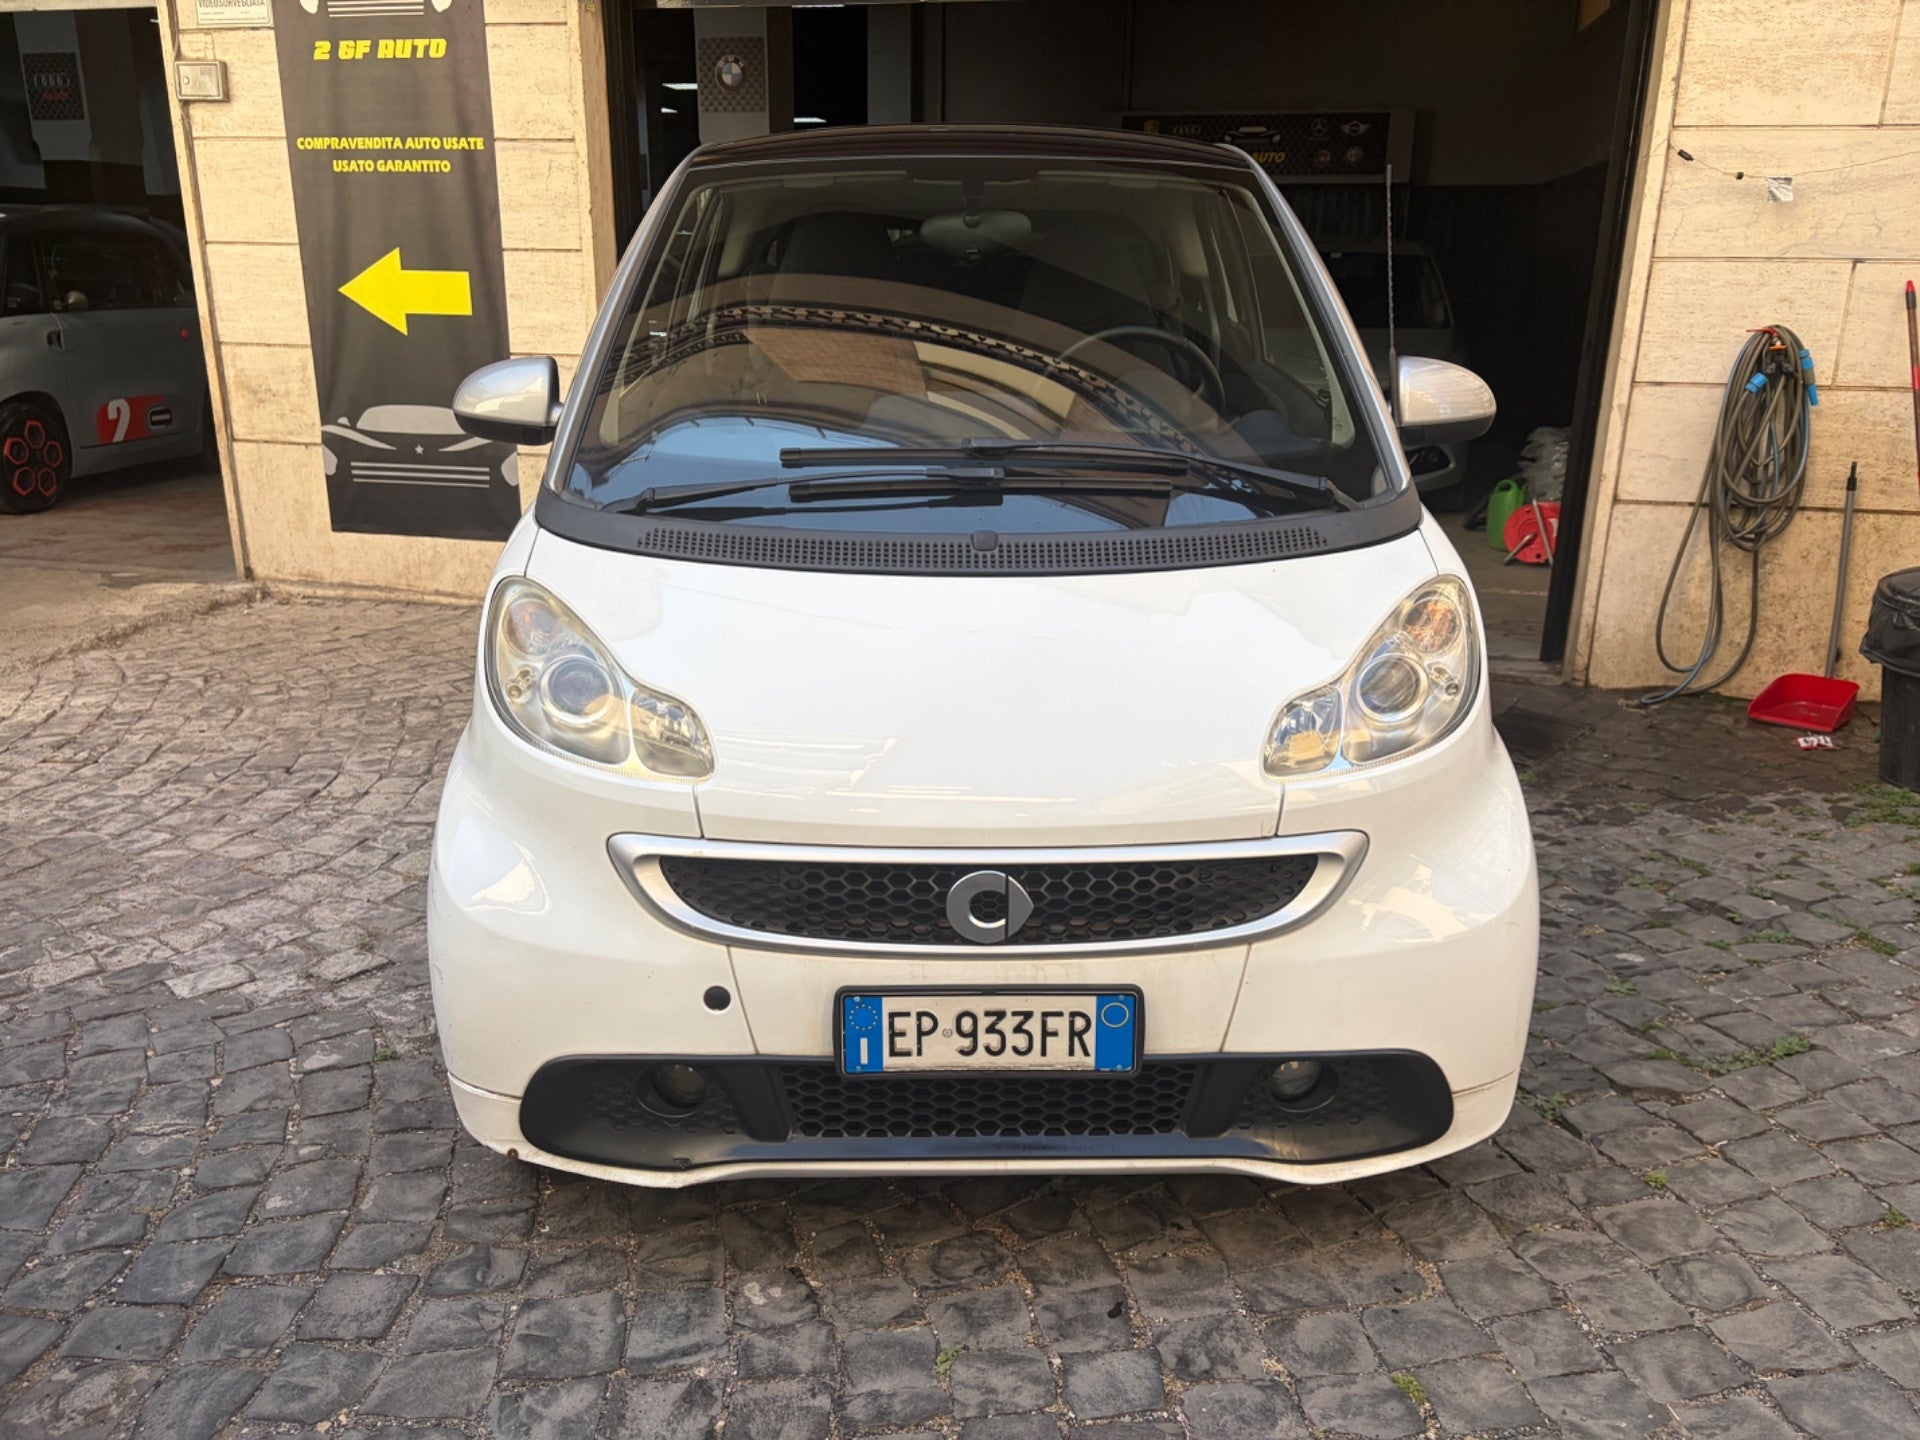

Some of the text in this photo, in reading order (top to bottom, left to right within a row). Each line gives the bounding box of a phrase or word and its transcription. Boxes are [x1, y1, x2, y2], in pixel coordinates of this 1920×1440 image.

[313, 40, 332, 60] 2
[377, 38, 447, 59] AUTO
[296, 136, 485, 150] COMPRAVENDITA AUTO USATE
[333, 159, 451, 173] USATO GARANTITO
[888, 1010, 1092, 1057] EP 933FR
